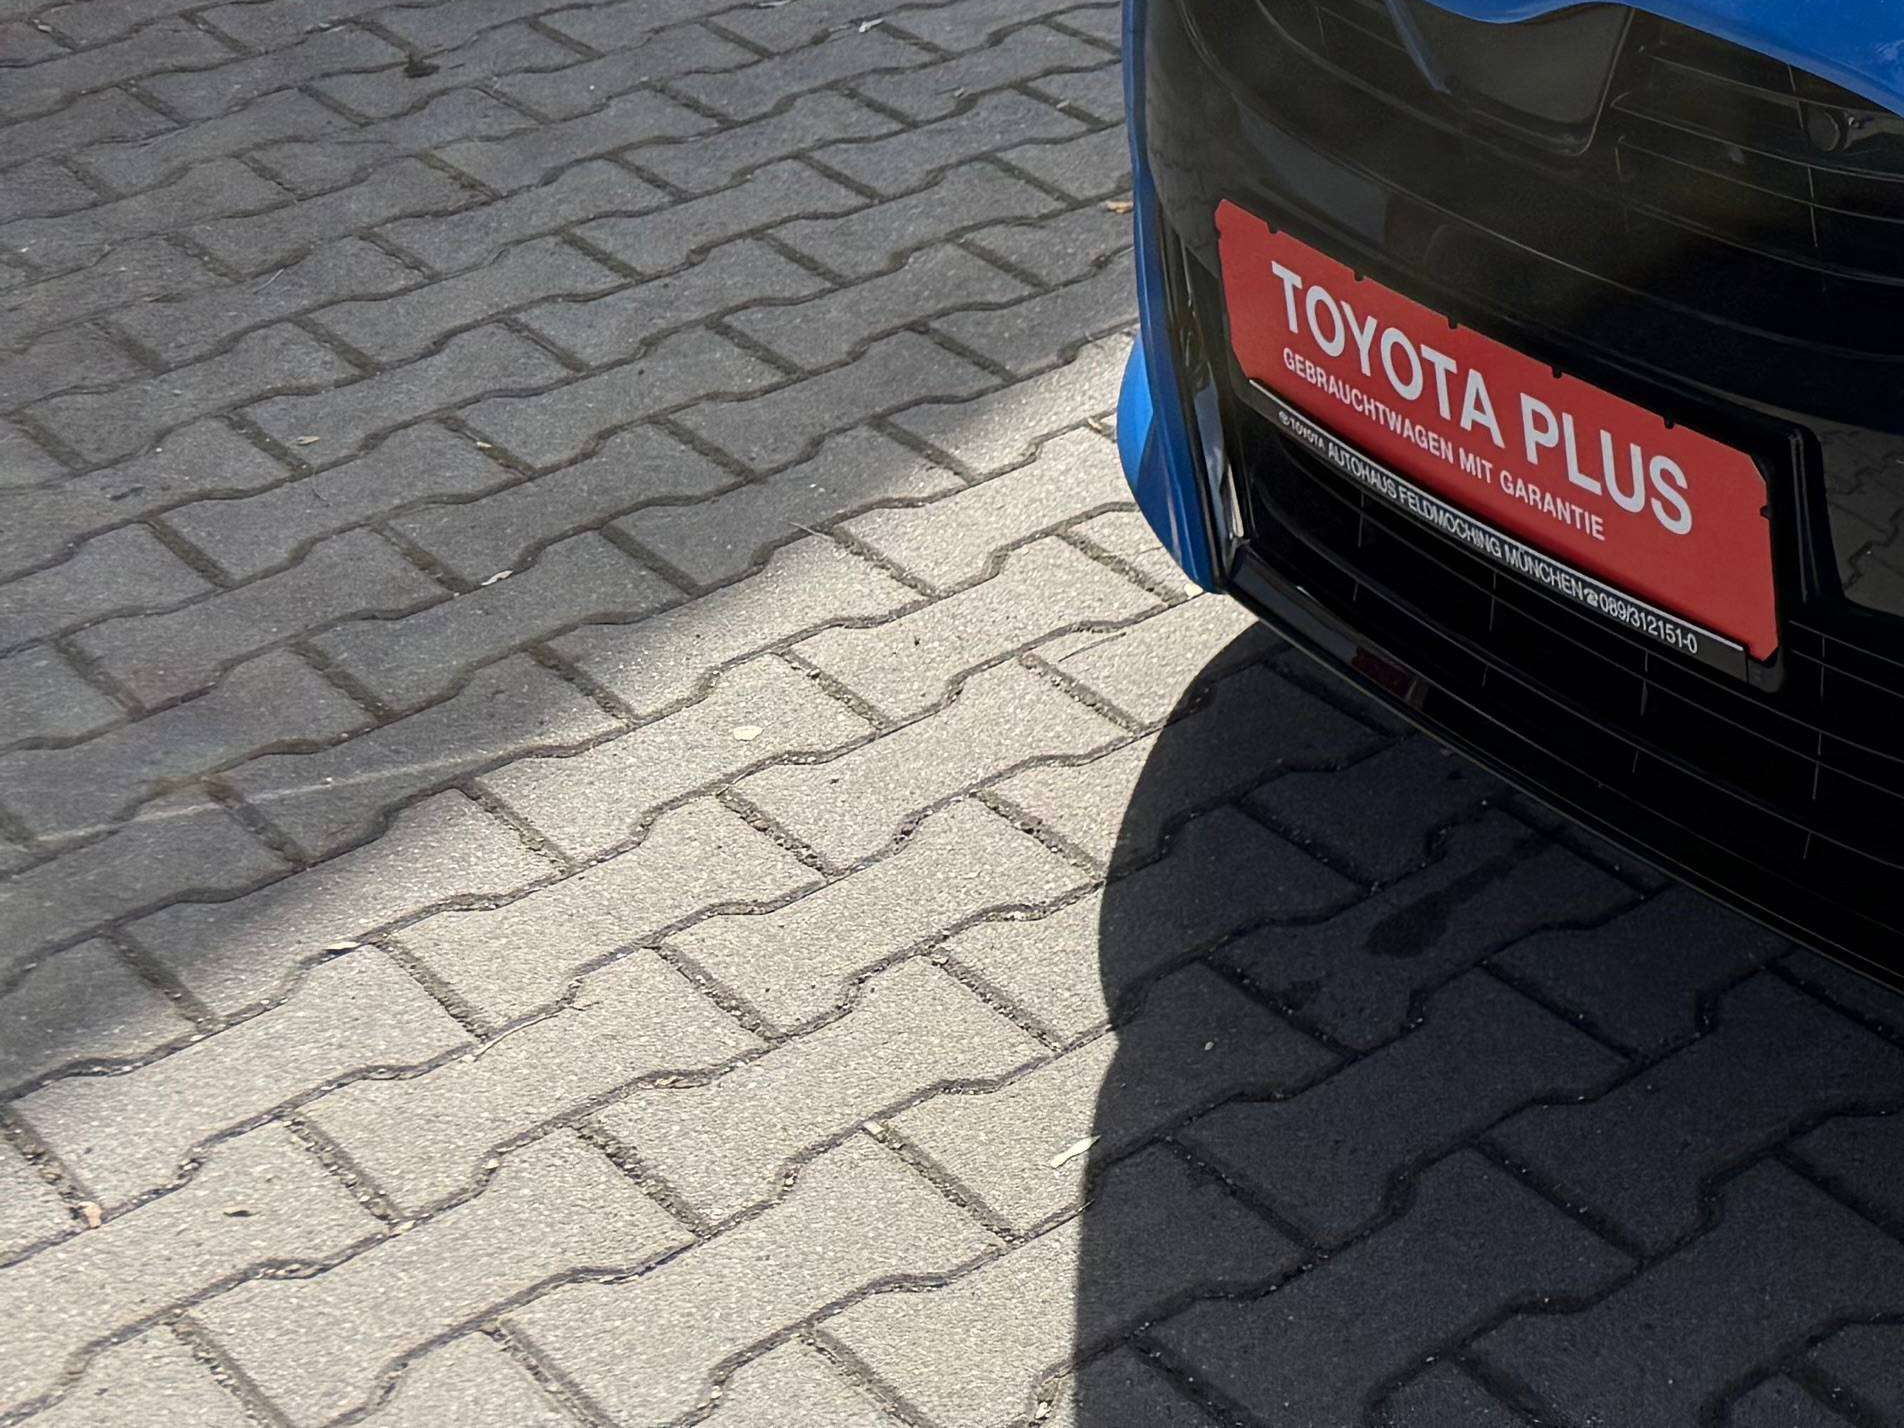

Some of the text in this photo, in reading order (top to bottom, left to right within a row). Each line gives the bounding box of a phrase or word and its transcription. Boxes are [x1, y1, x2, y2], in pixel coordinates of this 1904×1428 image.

[1271, 260, 1693, 535] TOYOTA PLUS
[1283, 347, 1606, 541] GEBRAUCHTWAGEN MIT GARANTIE
[1289, 418, 1698, 655] TOYOTA AUTOHAUS FELDMOCHING MÜNCHEN 089/312151-0
